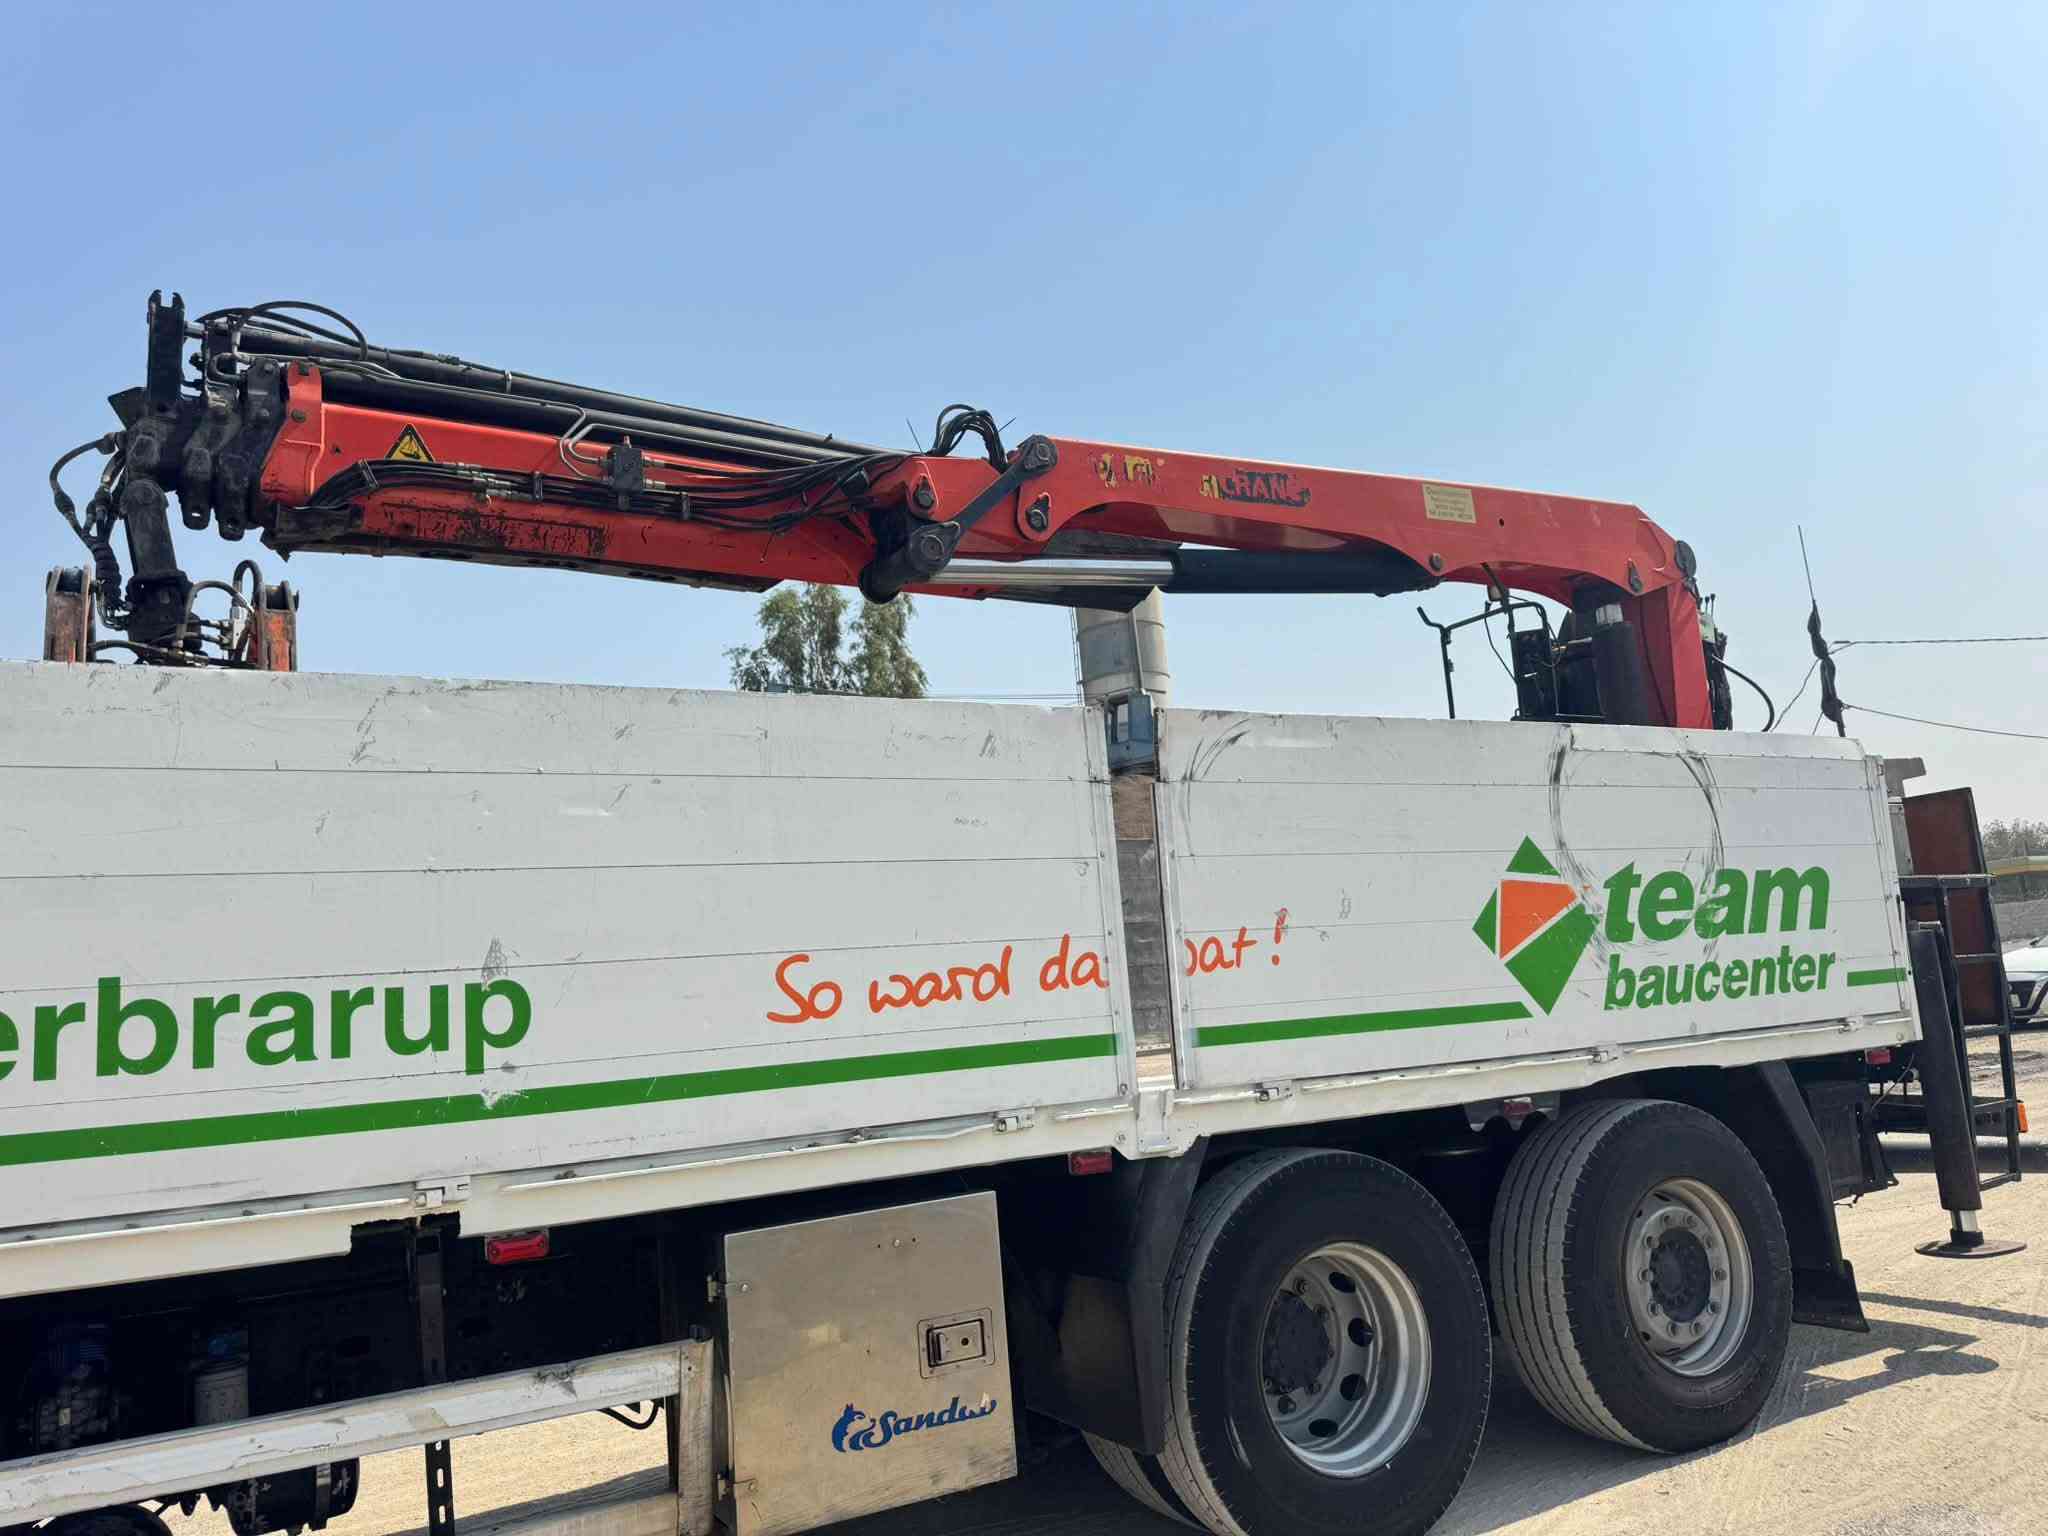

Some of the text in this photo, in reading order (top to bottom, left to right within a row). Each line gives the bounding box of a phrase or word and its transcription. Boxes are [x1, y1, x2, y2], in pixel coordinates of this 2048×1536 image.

[1603, 861, 1831, 943] team
[767, 953, 843, 1024] So
[868, 944, 1012, 1013] ward
[1603, 943, 1836, 1011] baucenter
